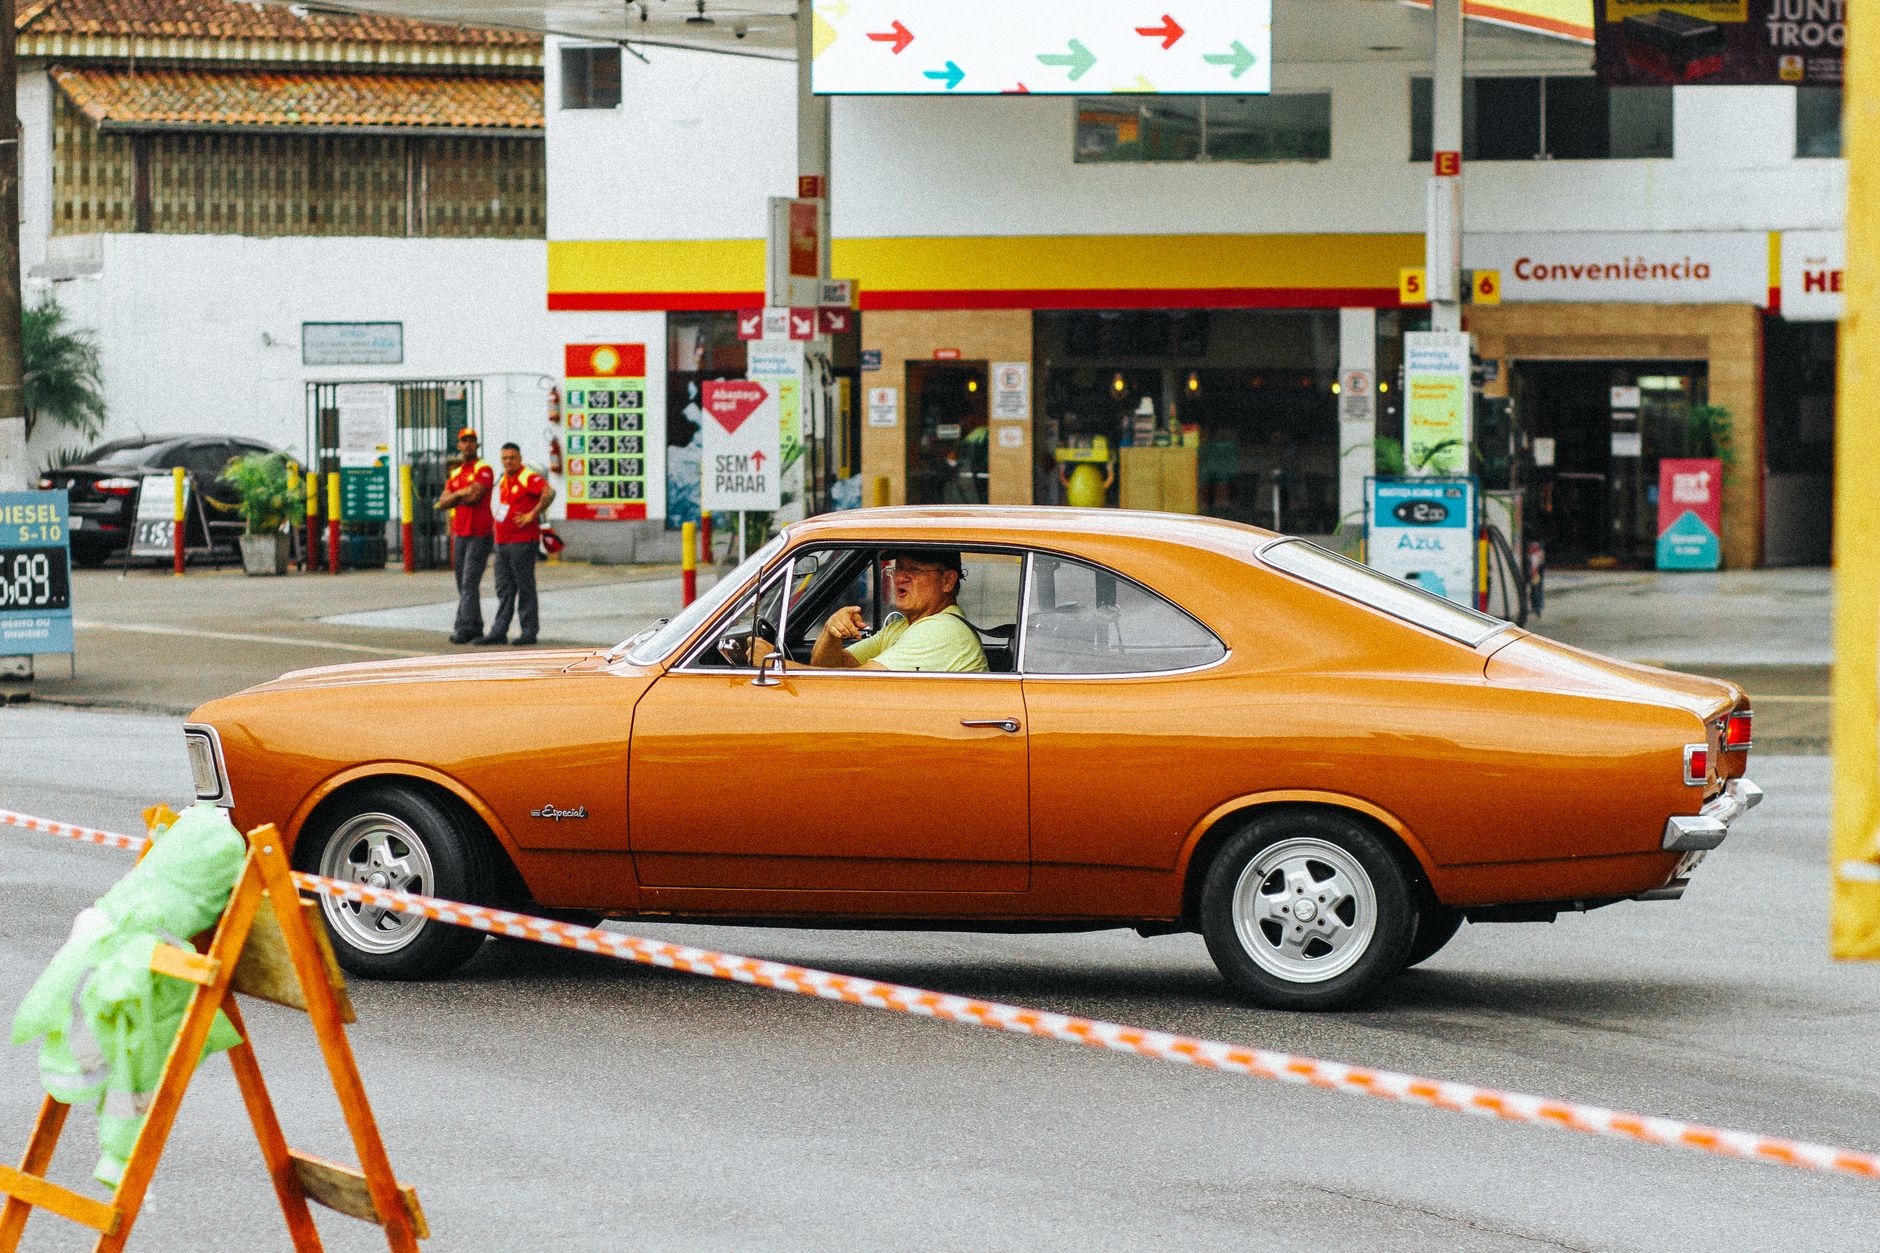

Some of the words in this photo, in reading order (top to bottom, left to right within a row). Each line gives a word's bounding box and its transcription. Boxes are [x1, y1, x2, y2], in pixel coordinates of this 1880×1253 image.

[1441, 153, 1454, 174] E
[1514, 256, 1711, 281] Conveniência
[1407, 275, 1419, 293] 5
[1480, 276, 1492, 295] 6
[716, 455, 748, 473] SEM
[715, 474, 766, 493] PARAR
[19, 524, 61, 543] S-10
[541, 803, 585, 821] Especial
